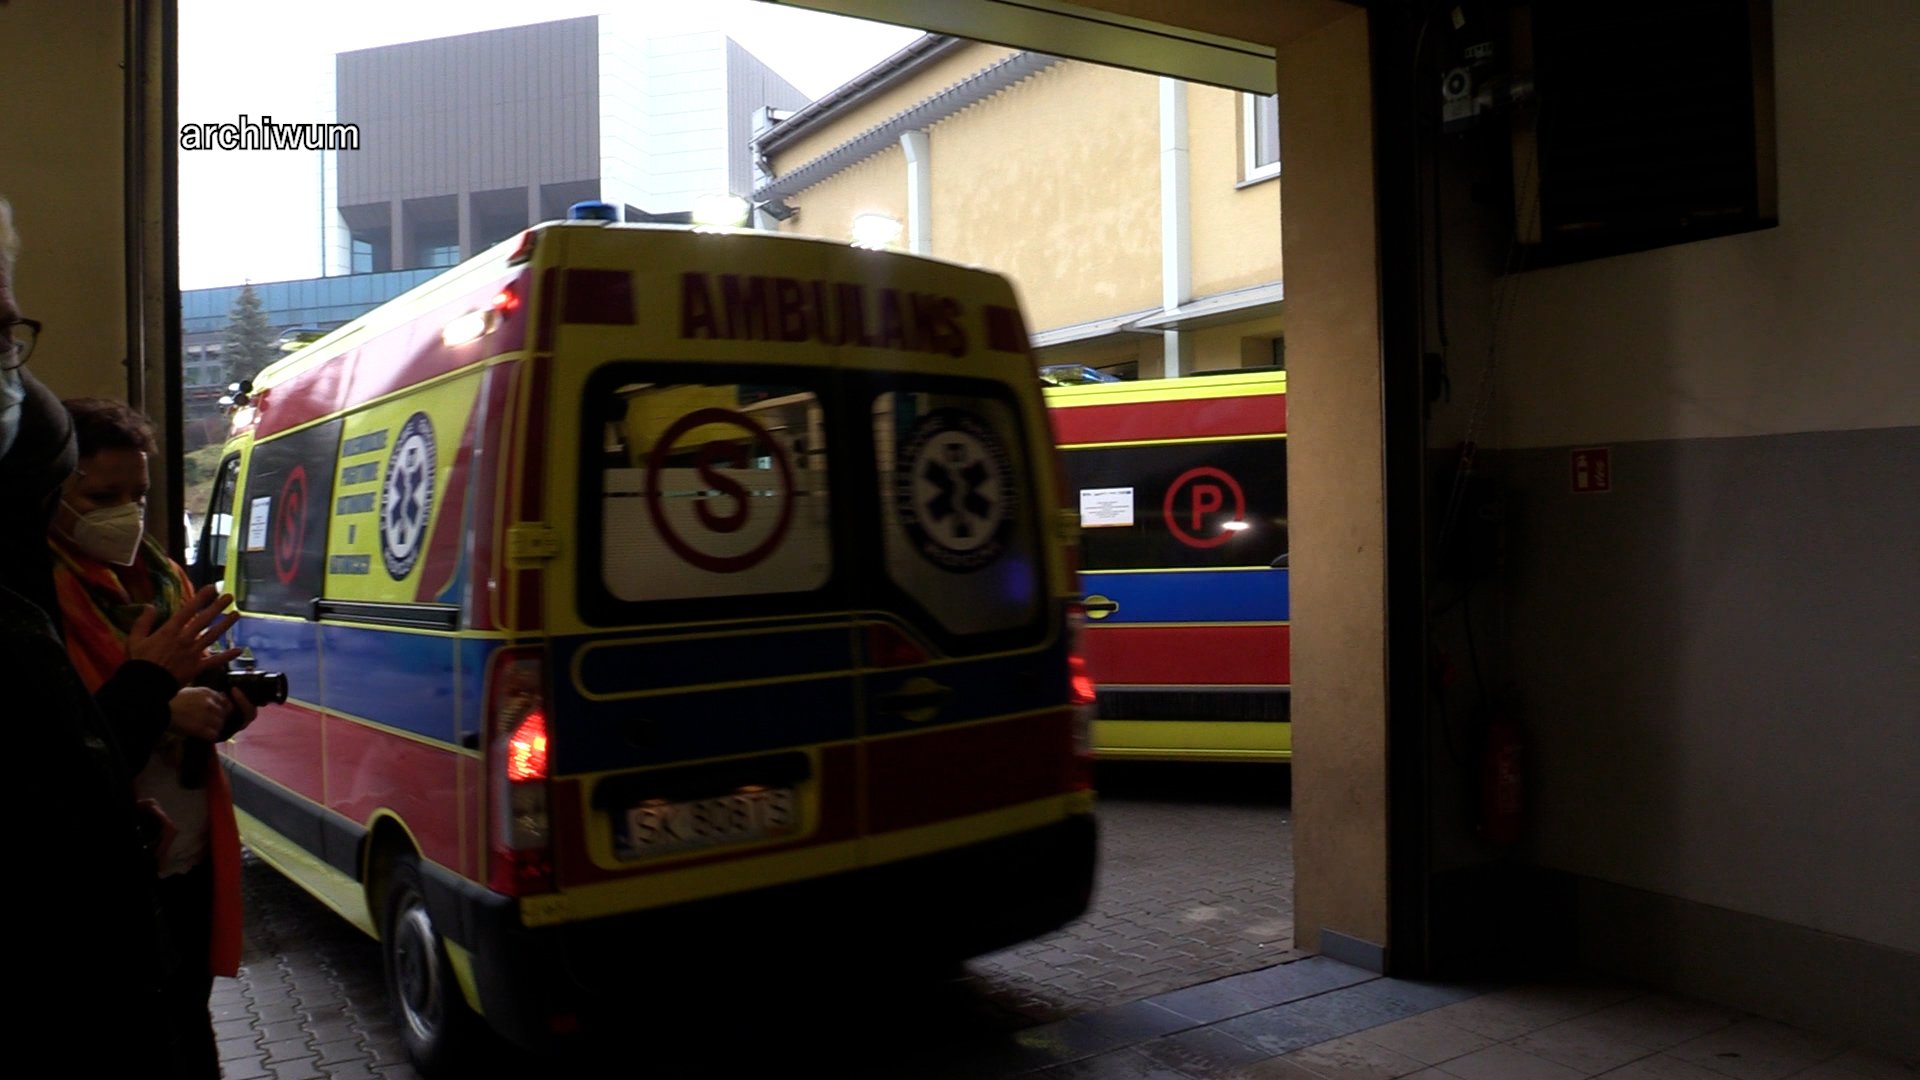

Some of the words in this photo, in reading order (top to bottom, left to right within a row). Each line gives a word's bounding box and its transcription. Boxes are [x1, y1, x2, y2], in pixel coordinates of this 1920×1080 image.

[682, 272, 967, 357] AMBULANS
[281, 491, 300, 560] S
[695, 442, 751, 532] S
[1191, 484, 1224, 531] P
